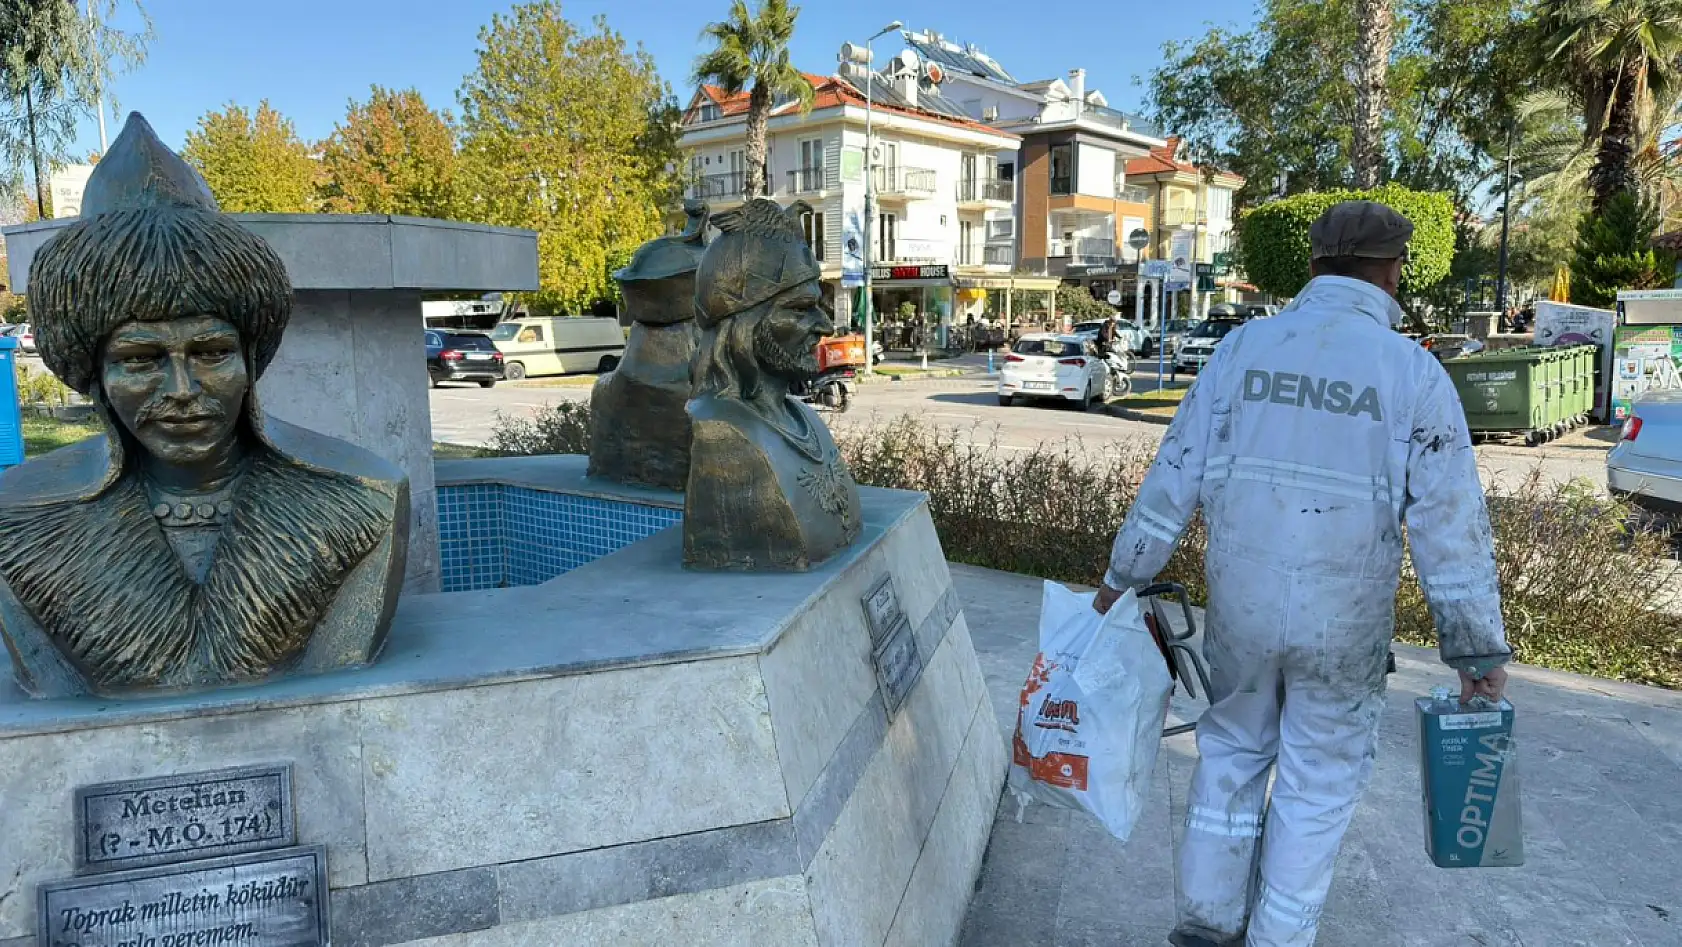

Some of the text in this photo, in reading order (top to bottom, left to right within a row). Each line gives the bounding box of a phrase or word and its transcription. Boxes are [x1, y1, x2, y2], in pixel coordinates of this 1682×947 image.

[920, 265, 946, 277] HOUSE
[1243, 369, 1383, 422] DENSA
[121, 786, 246, 819] Metehan
[1456, 732, 1510, 849] OPTIMA
[217, 812, 272, 840] 174)
[60, 876, 309, 933] Toprak milletin köküdür
[162, 921, 259, 947] veremem.
